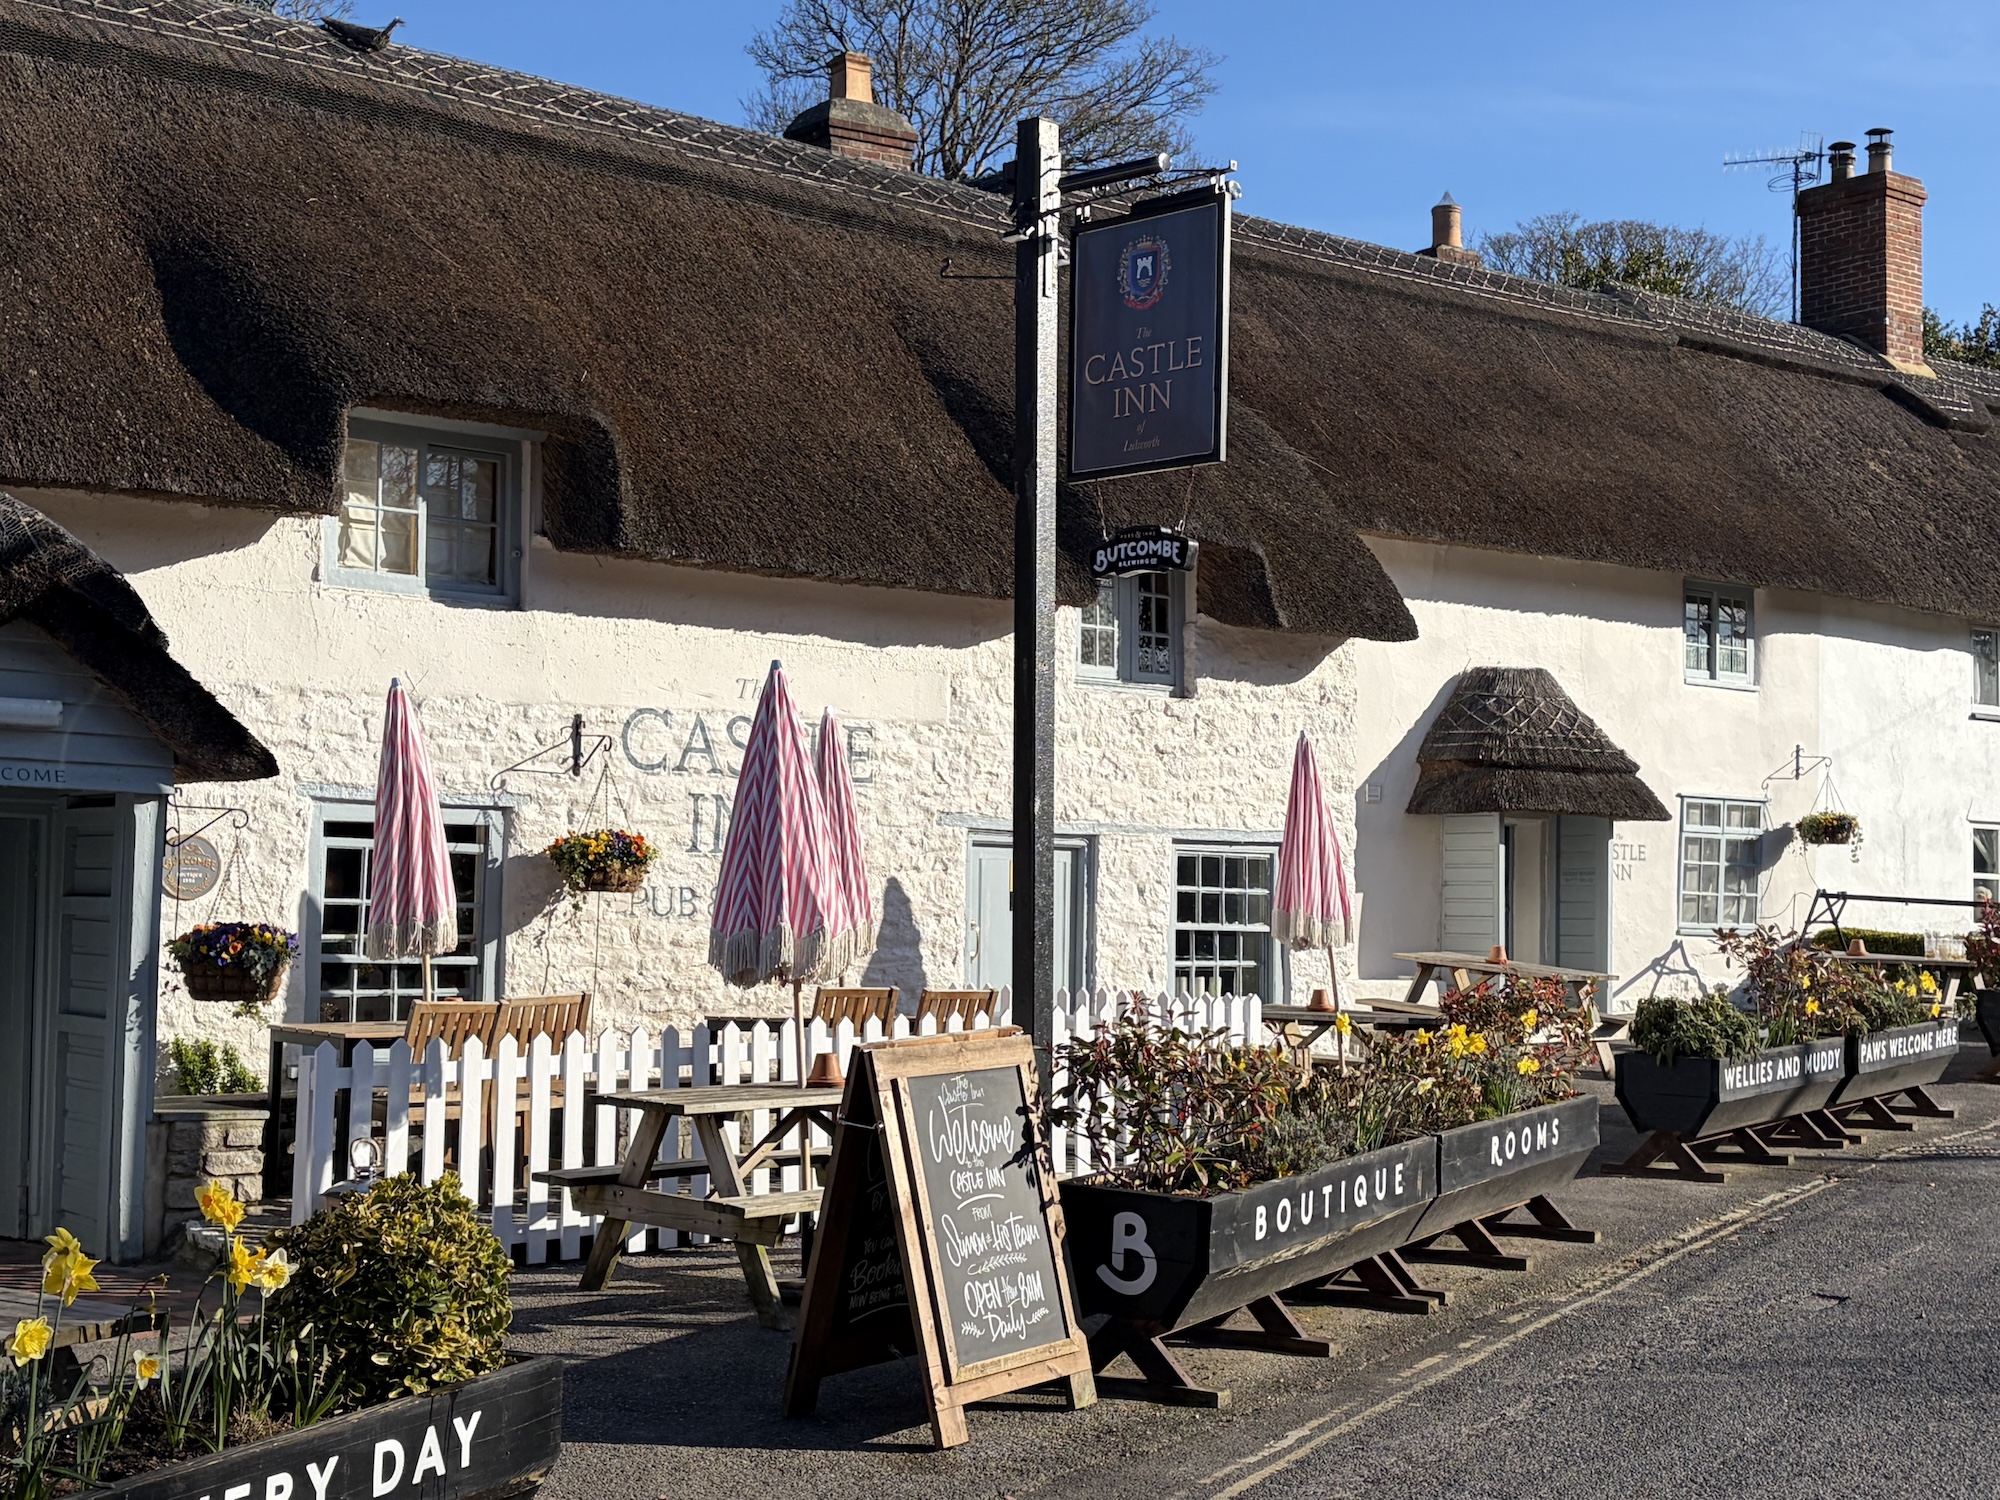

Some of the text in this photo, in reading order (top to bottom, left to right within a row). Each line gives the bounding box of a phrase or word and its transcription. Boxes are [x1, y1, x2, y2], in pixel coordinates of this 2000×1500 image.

[1136, 327, 1152, 339] The
[1085, 336, 1203, 385] CASTLE
[1113, 379, 1172, 419] INN
[1137, 419, 1146, 435] of
[1093, 540, 1181, 572] BUTCOMBE
[736, 677, 763, 700] Th
[1612, 843, 1647, 861] STLE
[629, 885, 698, 918] PUB
[1860, 1027, 1958, 1064] PAWS WELCOME HERE
[1724, 1048, 1840, 1090] WELLIES AND MUDDY
[929, 1096, 1014, 1165] Welcome
[1491, 1118, 1560, 1167] ROOMS
[950, 1165, 1006, 1199] CASTLE INN
[1254, 1162, 1404, 1241] BOUTIQUE
[972, 1204, 992, 1221] FROM
[942, 1214, 989, 1267] Simon
[964, 1276, 1002, 1318] OPEN
[1017, 1270, 1045, 1308] 8AM
[982, 1298, 1027, 1342] Daily
[372, 1410, 482, 1498] DAY
